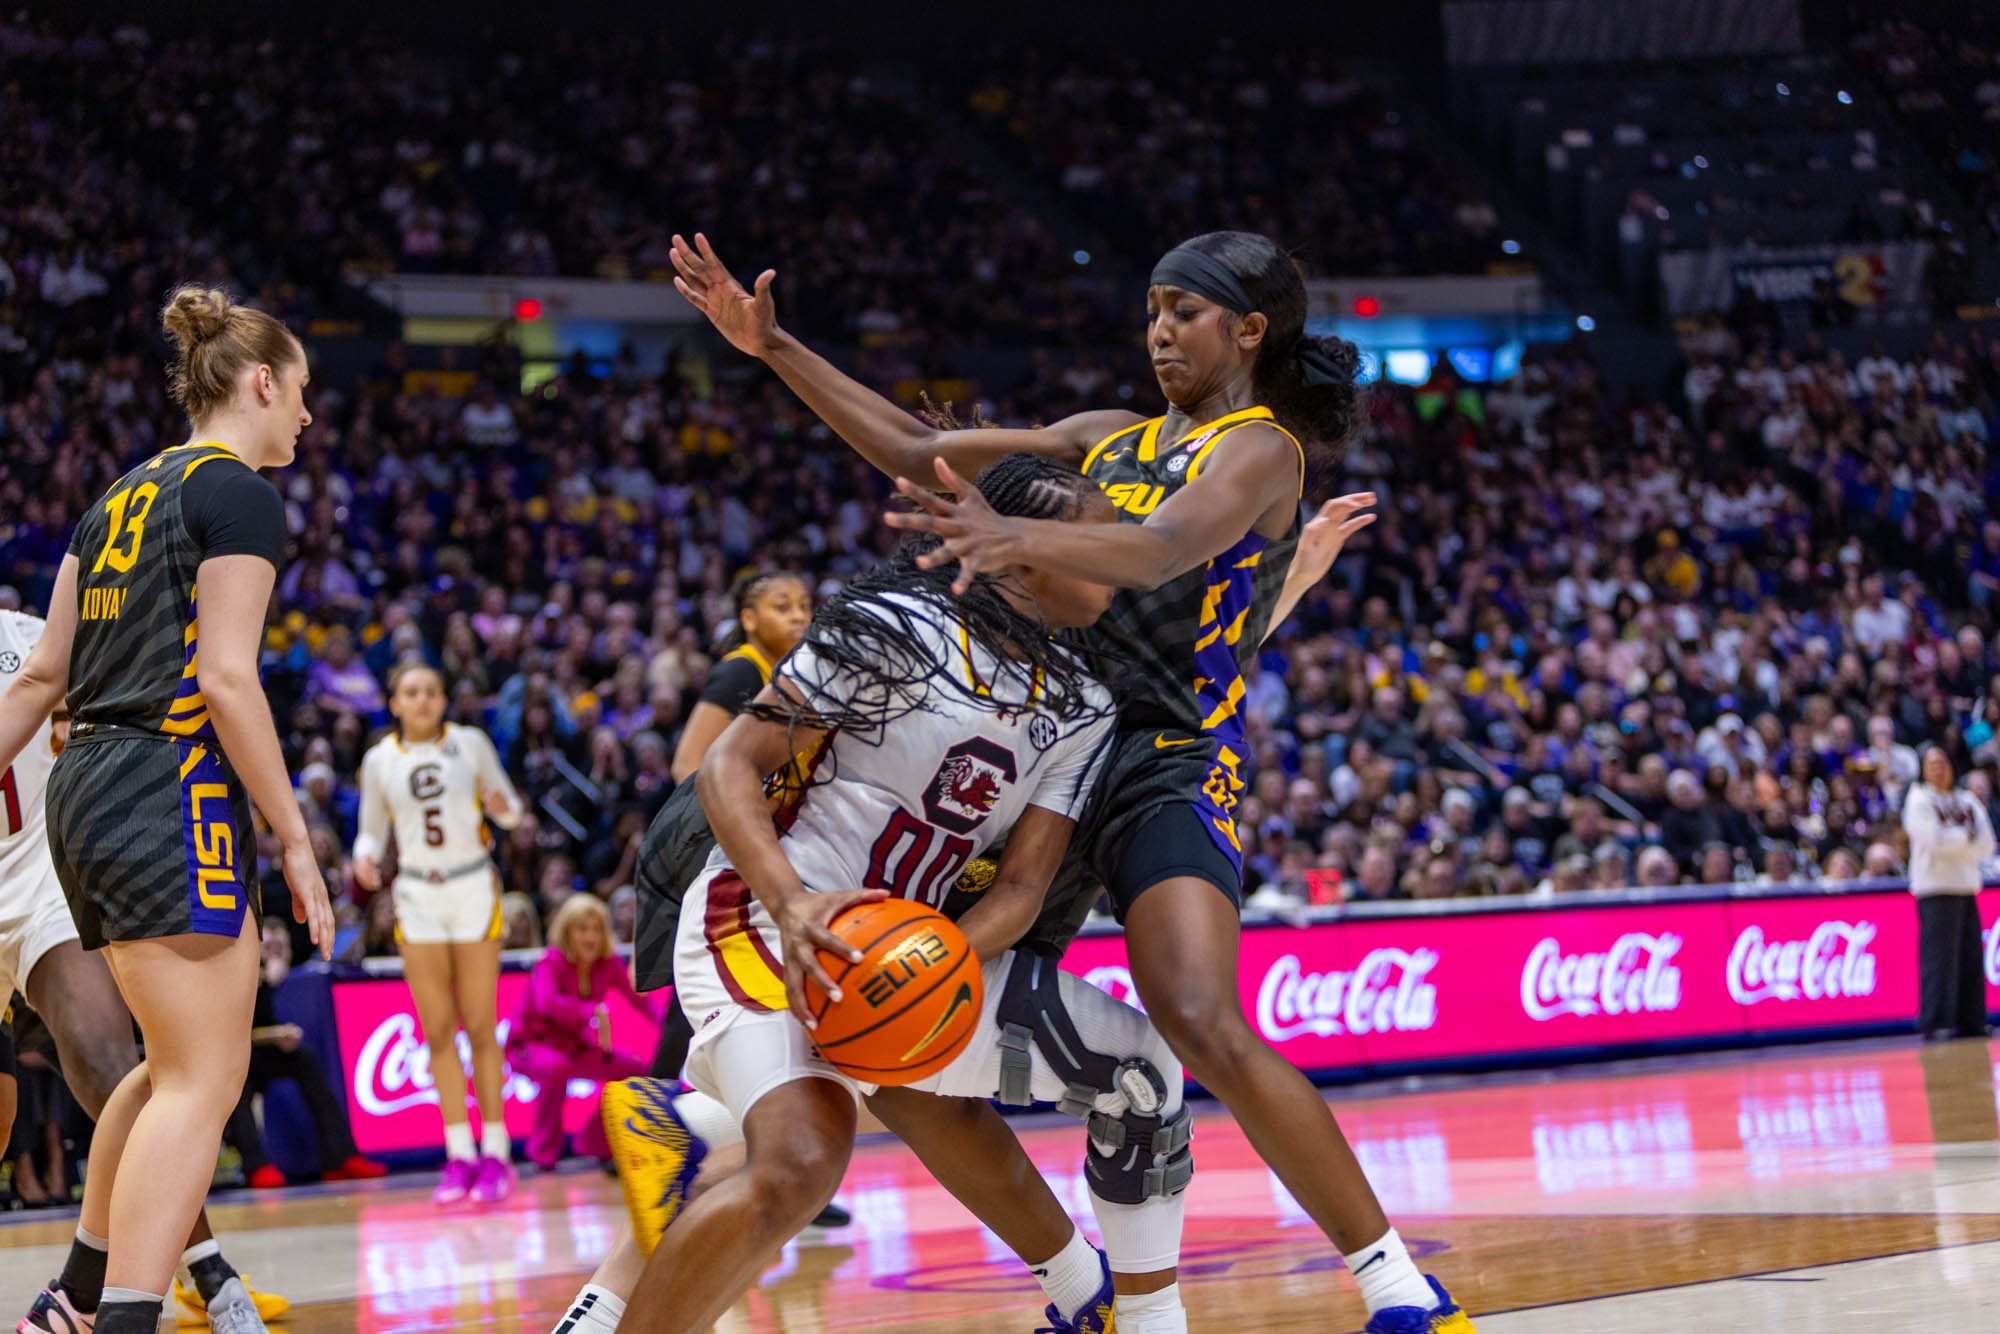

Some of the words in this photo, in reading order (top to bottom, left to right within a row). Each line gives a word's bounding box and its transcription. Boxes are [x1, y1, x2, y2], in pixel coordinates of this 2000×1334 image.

[92, 481, 160, 574] 13
[1099, 482, 1165, 515] SU
[190, 783, 236, 910] LSU
[424, 808, 444, 847] 5
